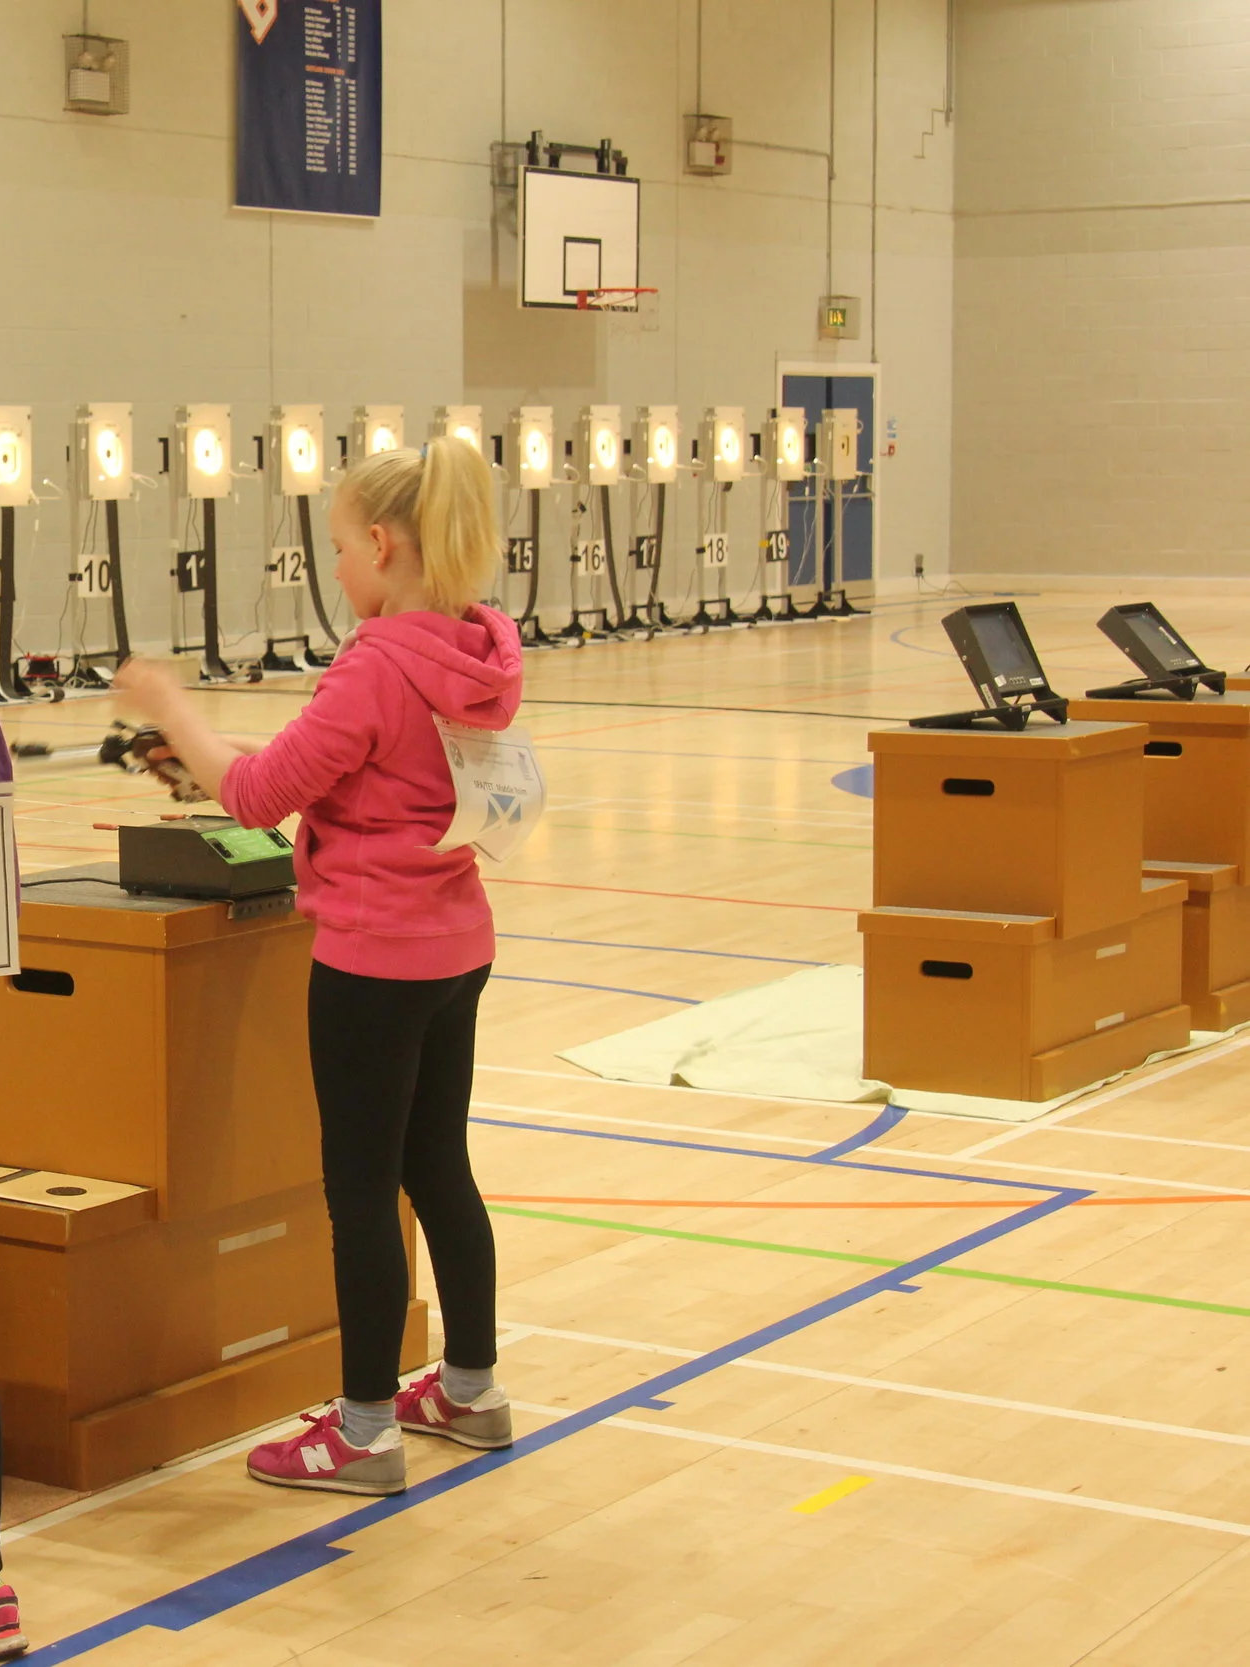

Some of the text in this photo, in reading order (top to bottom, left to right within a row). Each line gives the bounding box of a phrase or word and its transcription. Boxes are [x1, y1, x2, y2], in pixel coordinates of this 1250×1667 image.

[512, 540, 533, 571] 15
[581, 544, 600, 573] 16
[640, 537, 657, 567] 17
[707, 537, 725, 563] 18
[768, 532, 788, 561] 19
[84, 559, 111, 593] 10
[277, 551, 302, 583] 12
